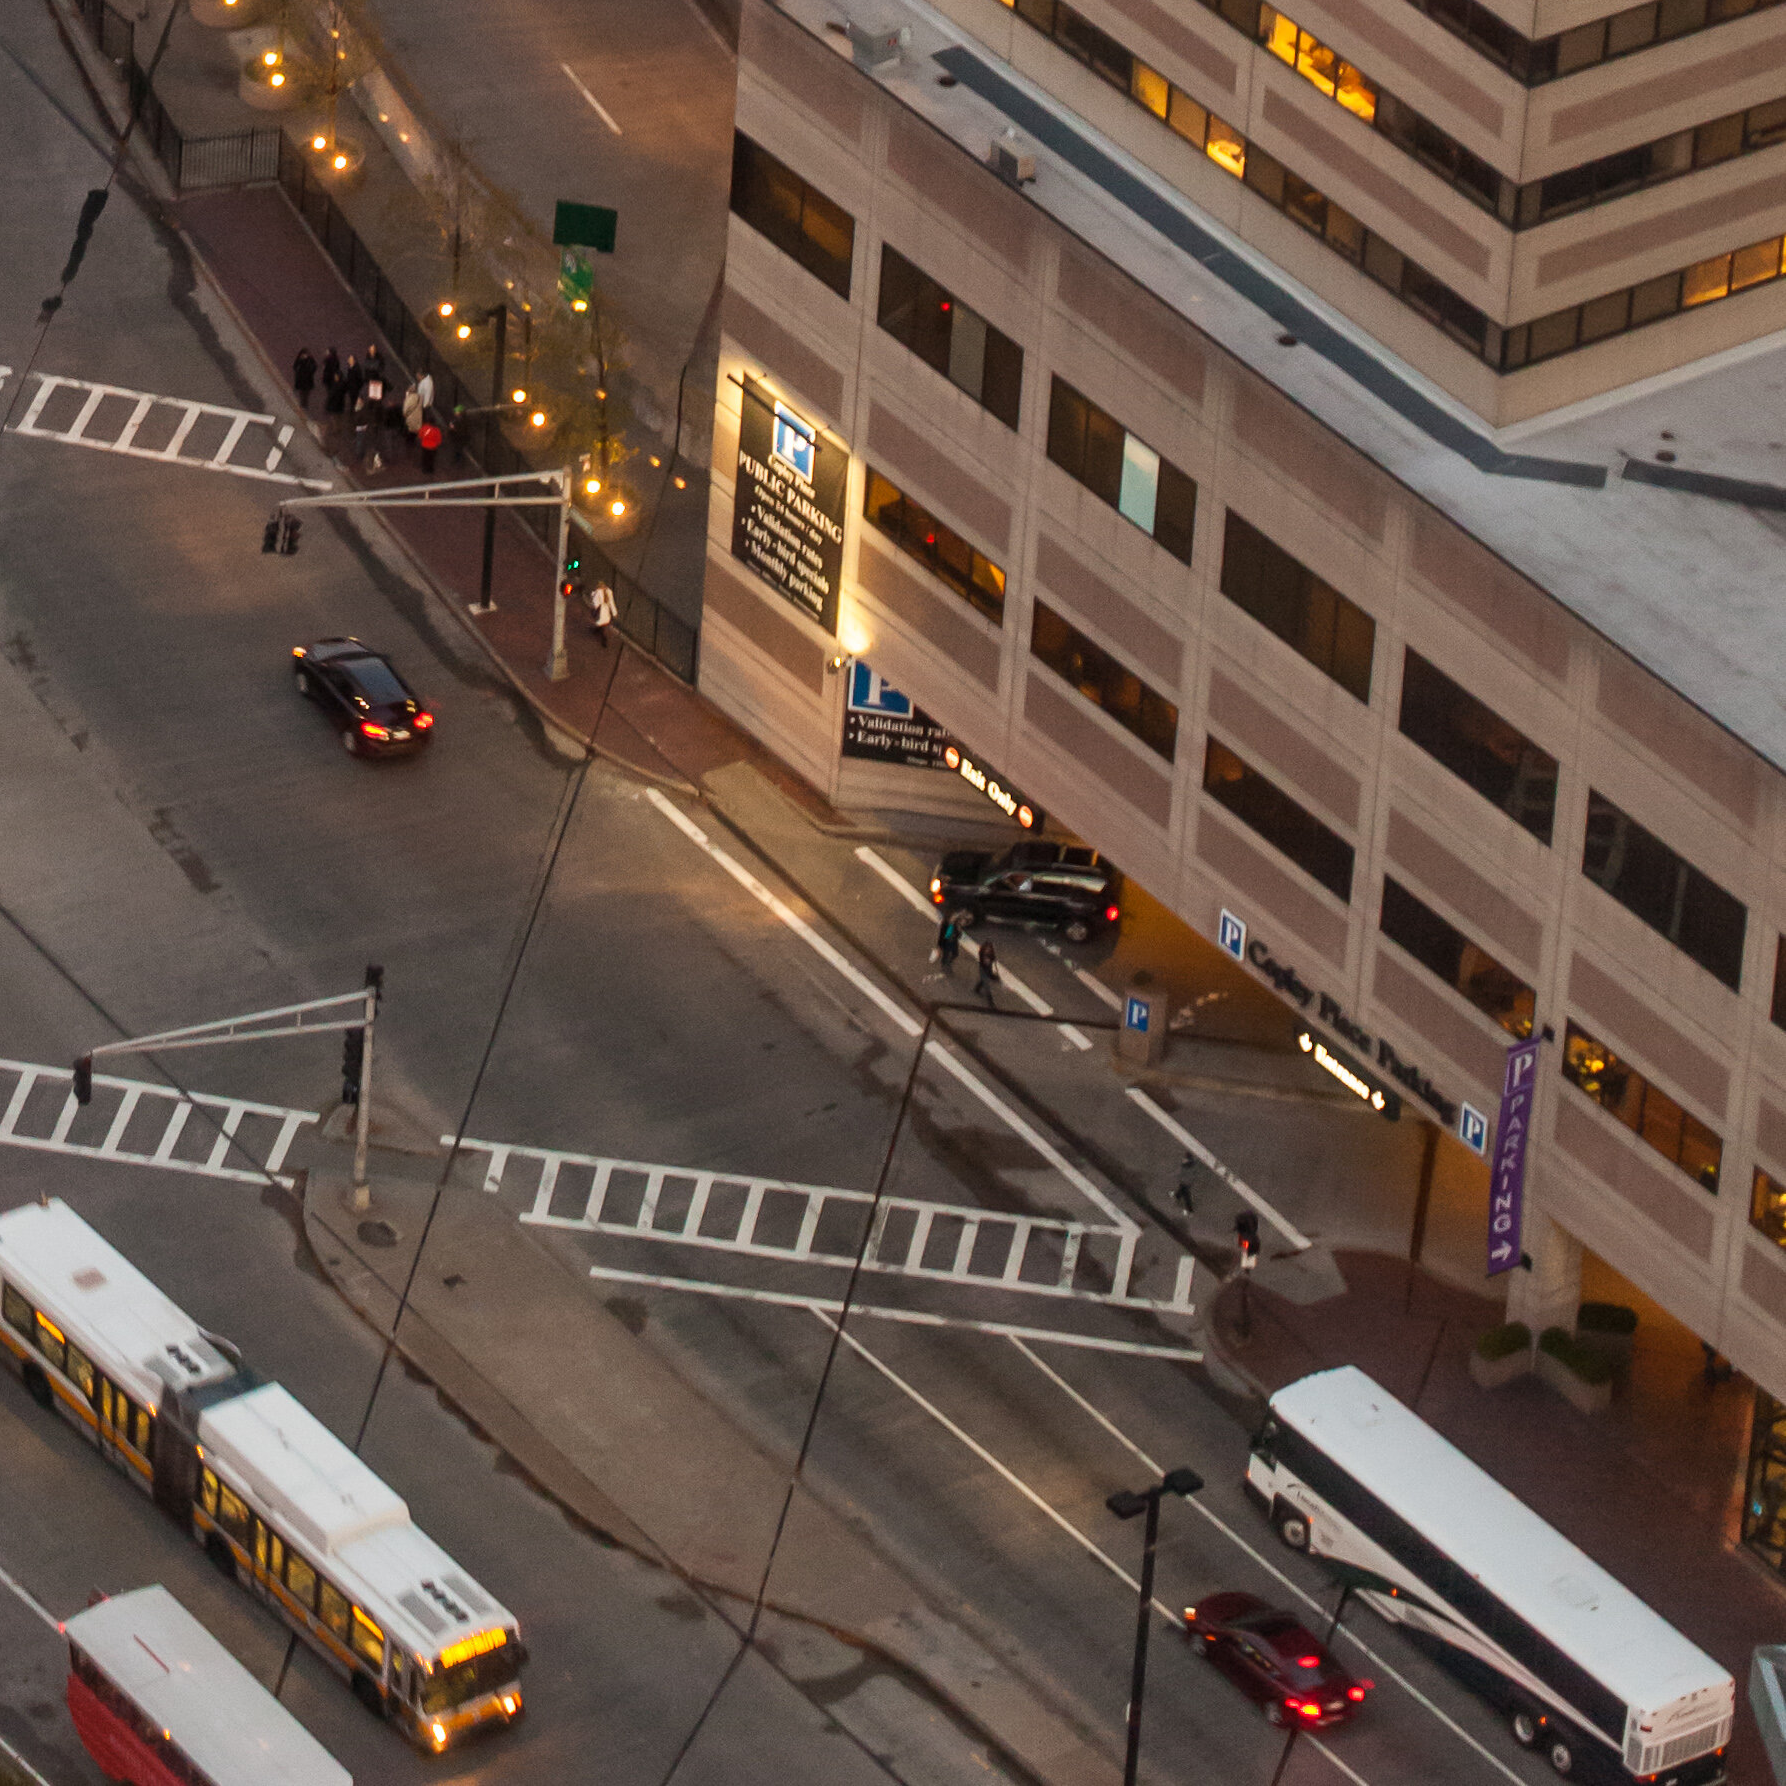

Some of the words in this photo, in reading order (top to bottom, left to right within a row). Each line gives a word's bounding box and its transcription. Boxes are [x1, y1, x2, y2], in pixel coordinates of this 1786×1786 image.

[783, 422, 808, 464] P
[739, 450, 786, 499] PUBLIC
[786, 487, 843, 545] PARKING
[757, 504, 802, 551] Validation
[750, 540, 788, 583] Monthly
[788, 572, 824, 613] parking
[796, 559, 830, 595] specials
[858, 714, 924, 736] Validation
[960, 757, 987, 791] Exit
[987, 780, 1018, 816] Only
[1131, 1003, 1148, 1025] P
[1226, 919, 1240, 953] P
[1248, 939, 1313, 1008] Copley
[1319, 991, 1372, 1054] Place
[1377, 1037, 1458, 1126] Parking
[1467, 1115, 1481, 1146] P
[1513, 1052, 1534, 1088] P
[1494, 1093, 1525, 1234] PARKING
